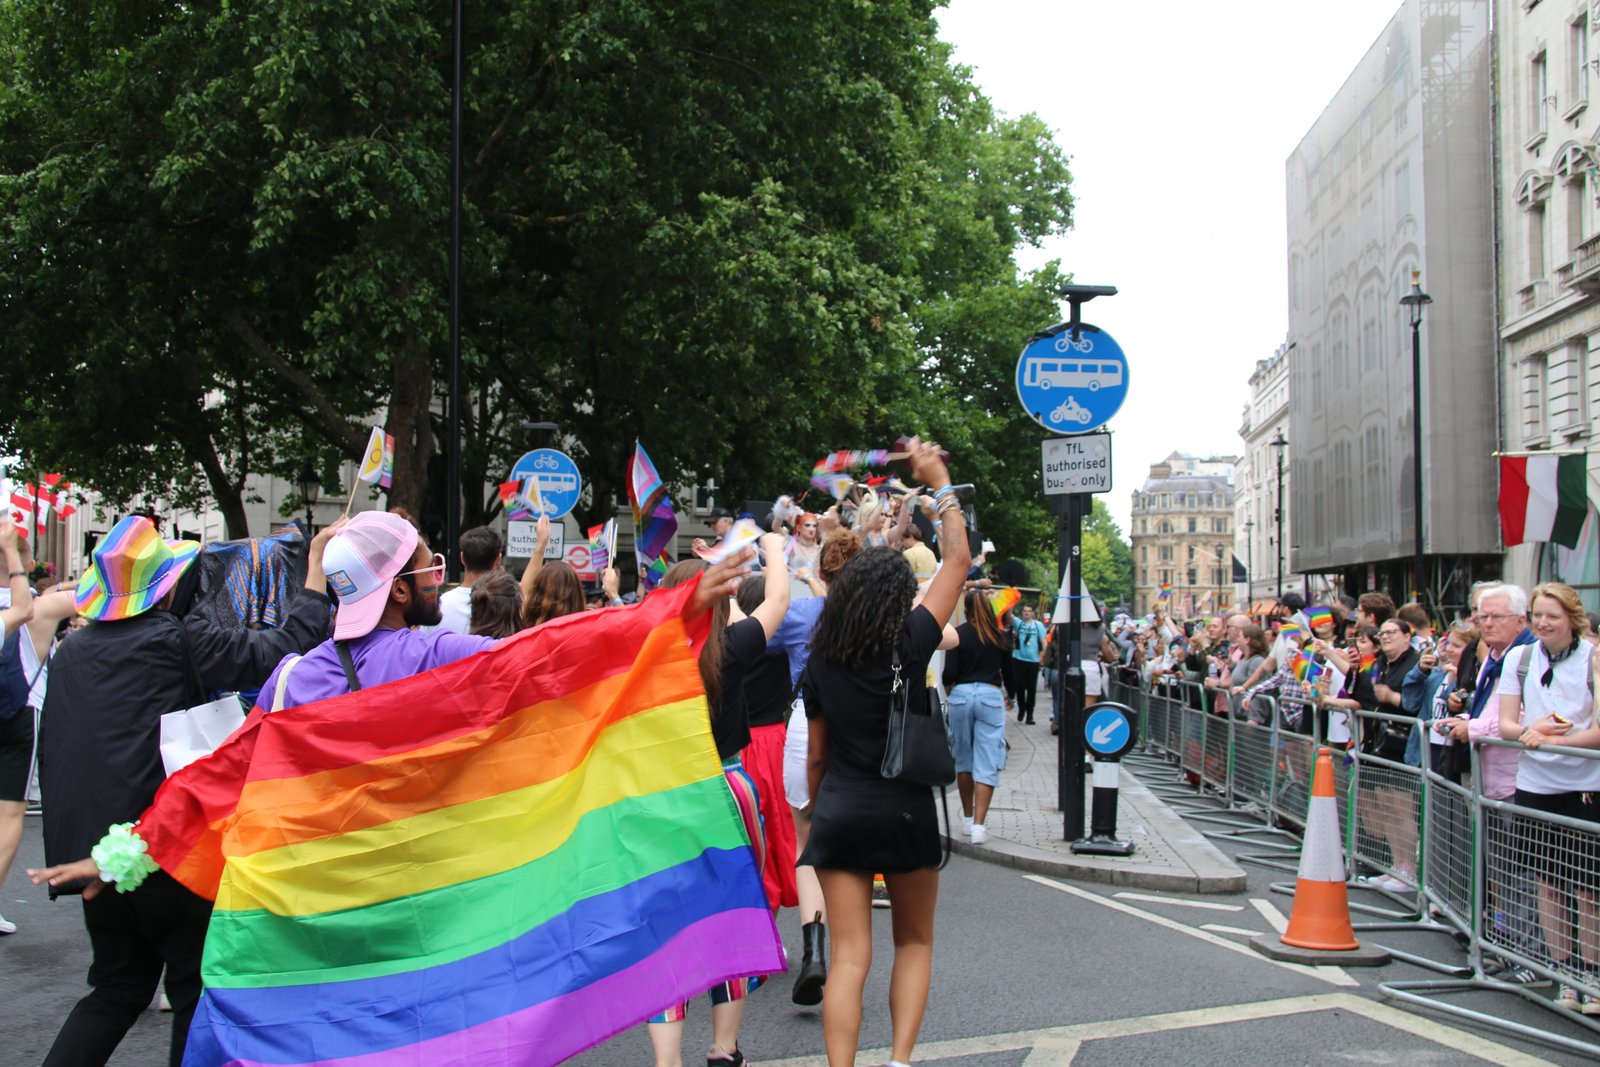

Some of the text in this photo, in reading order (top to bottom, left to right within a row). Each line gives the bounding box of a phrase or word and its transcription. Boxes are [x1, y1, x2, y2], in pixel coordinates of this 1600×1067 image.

[1065, 442, 1085, 455] TfL
[1046, 456, 1106, 473] authorised
[1046, 473, 1106, 489] bus only
[511, 535, 560, 545] authoed
[1072, 545, 1080, 556] 3
